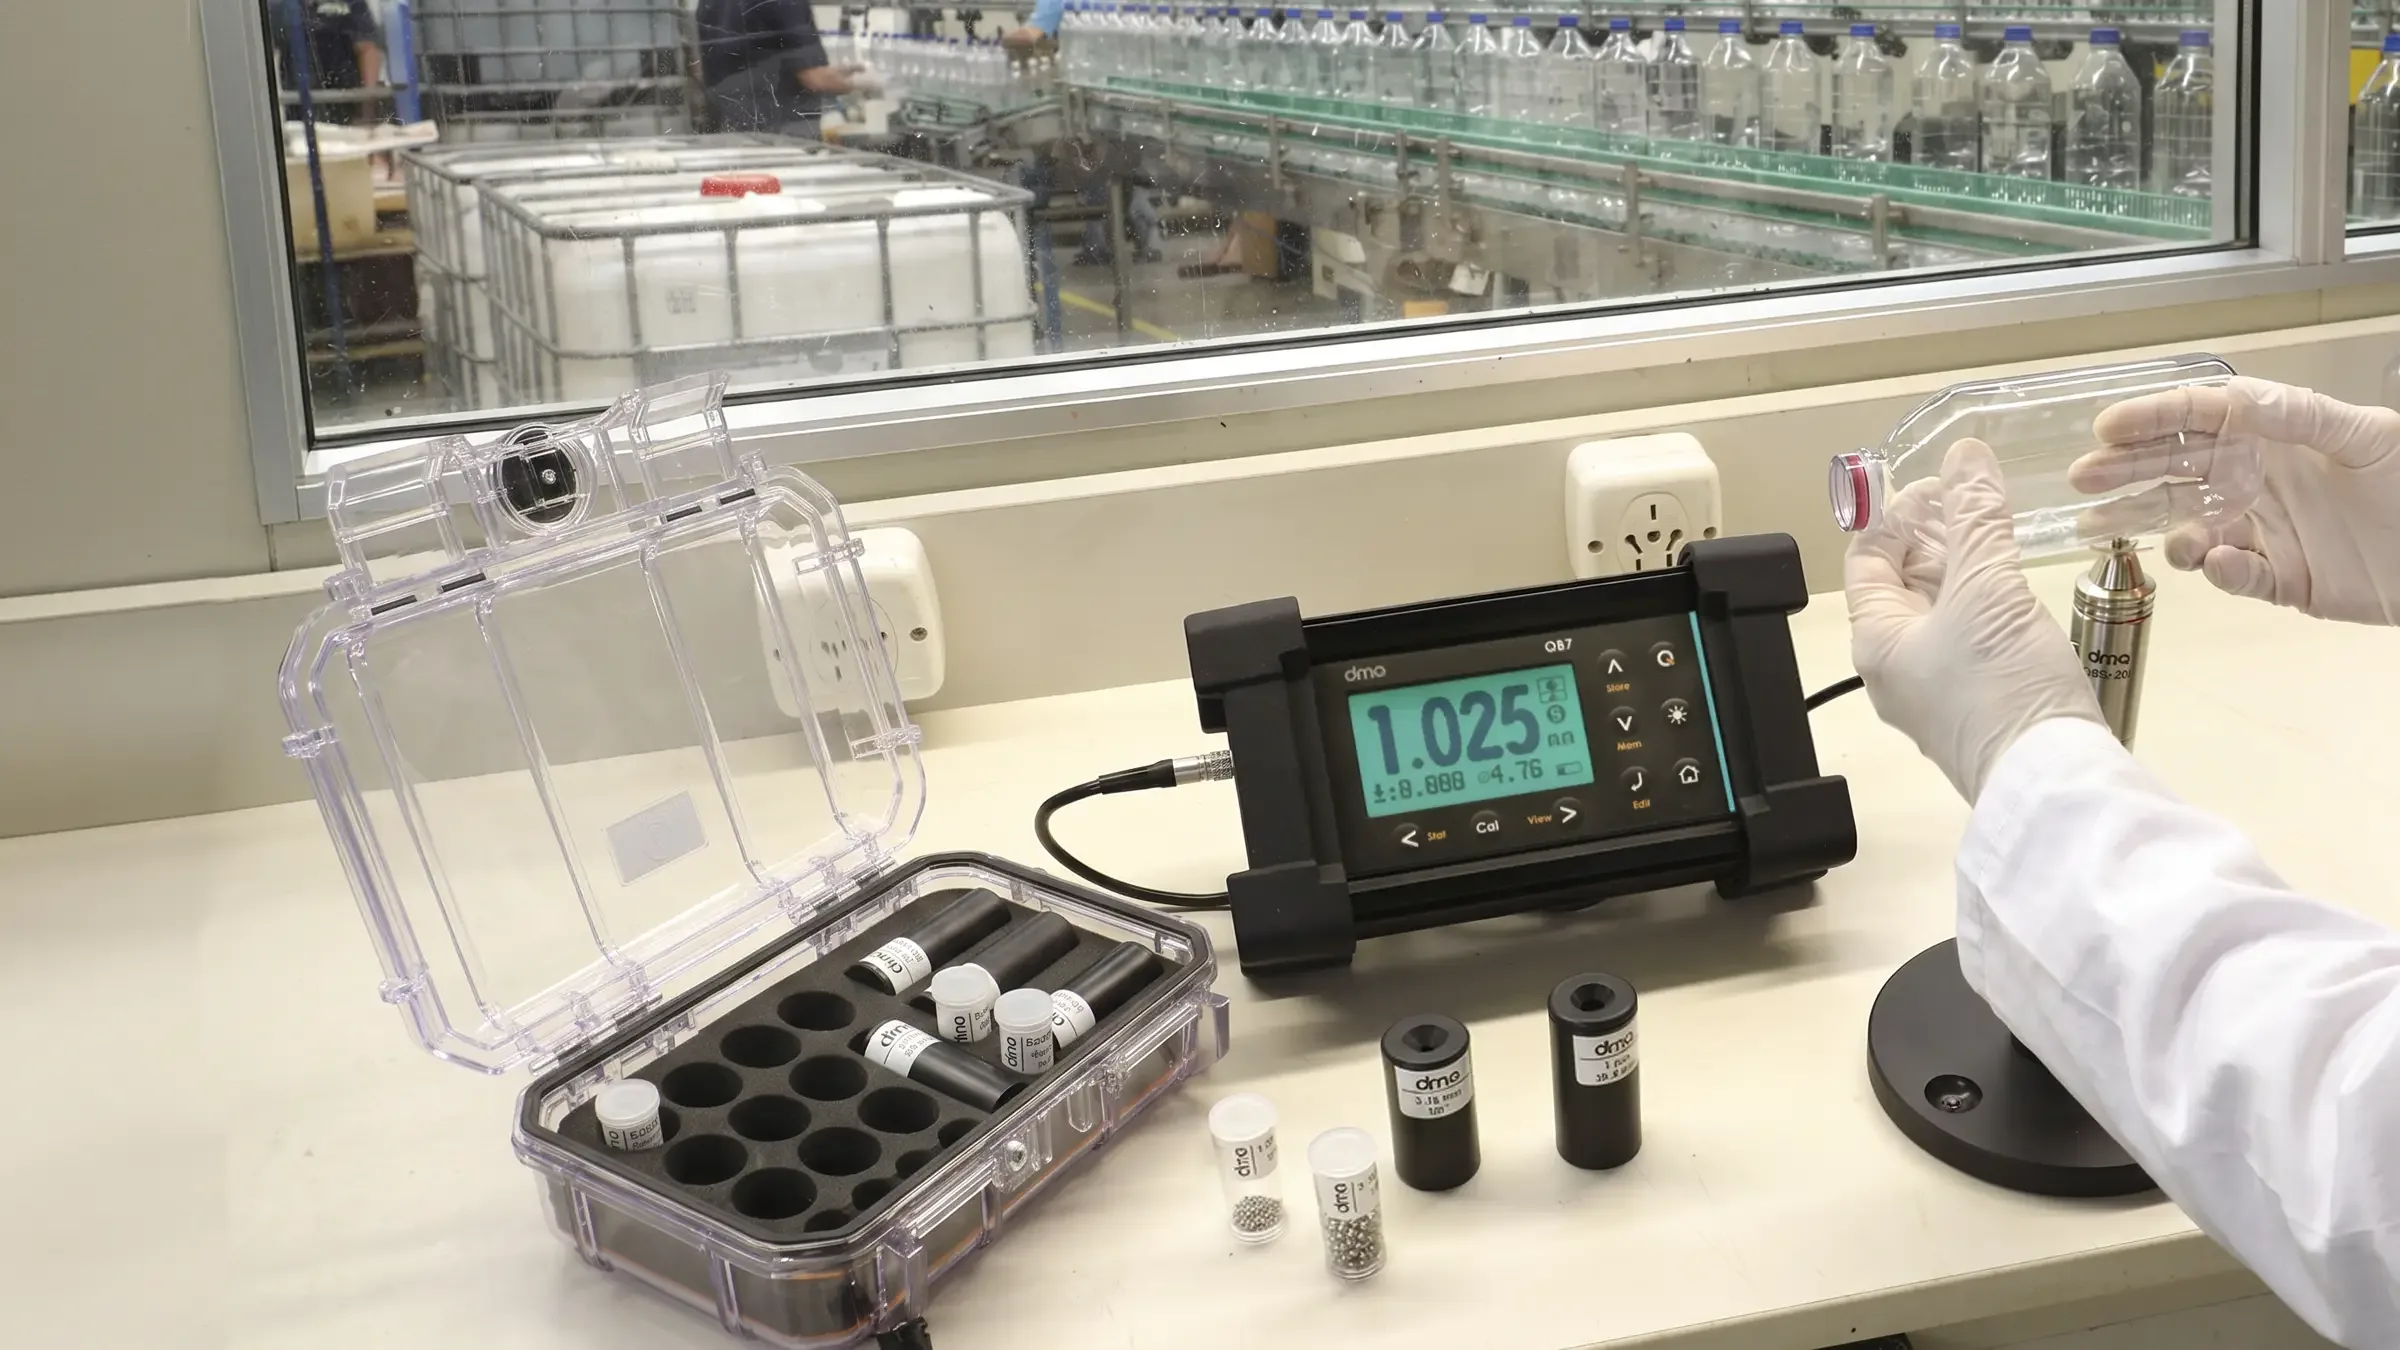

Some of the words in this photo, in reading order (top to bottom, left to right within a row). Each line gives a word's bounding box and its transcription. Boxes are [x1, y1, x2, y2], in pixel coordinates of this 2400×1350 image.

[1606, 683, 1630, 693] Store
[1367, 684, 1540, 775] 1.025
[1617, 741, 1642, 752] Mem
[1527, 814, 1552, 825] View
[1475, 820, 1499, 834] Cal
[1427, 830, 1446, 842] Stat
